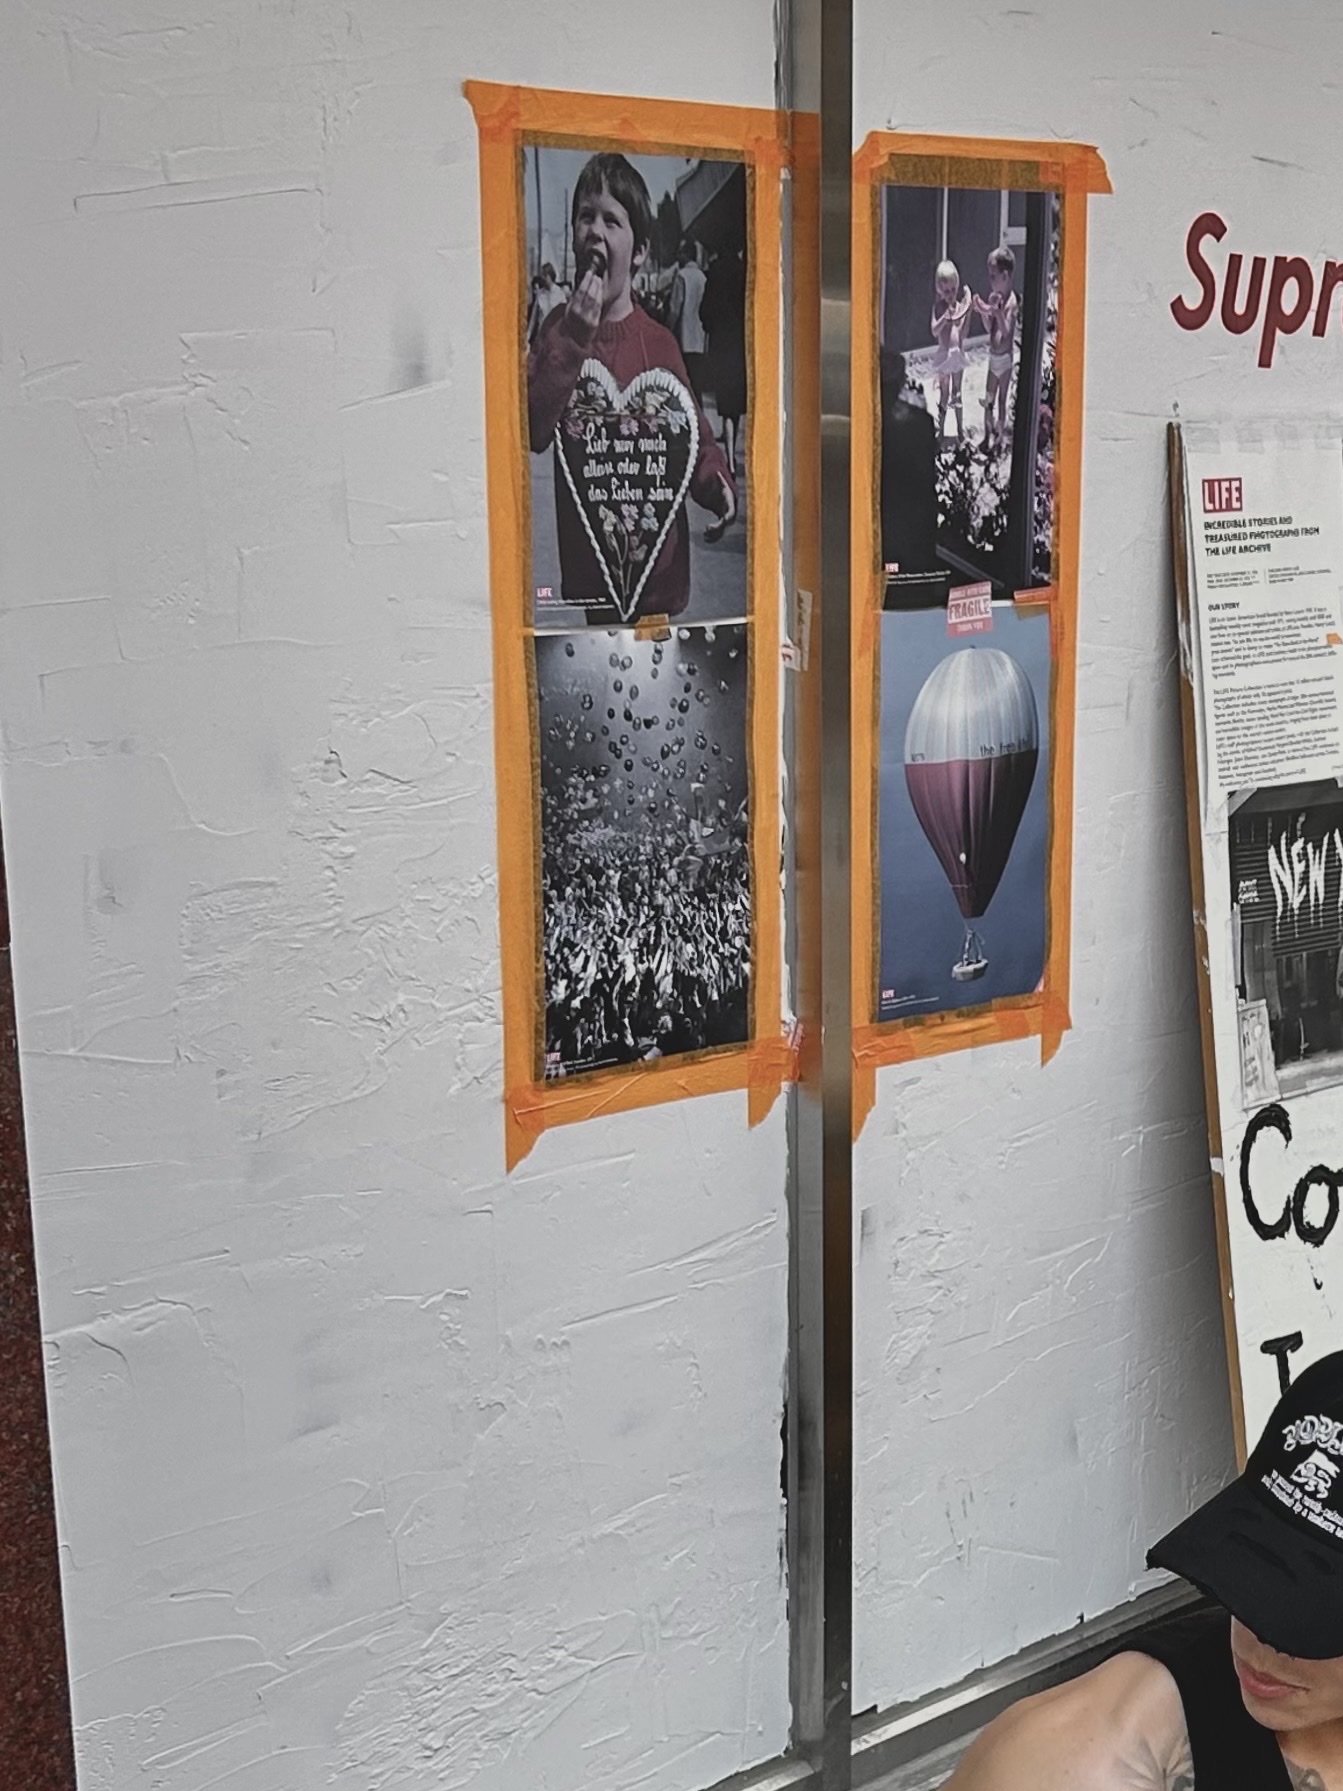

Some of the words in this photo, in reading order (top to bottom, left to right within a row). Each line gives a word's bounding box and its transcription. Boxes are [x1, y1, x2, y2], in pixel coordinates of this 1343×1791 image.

[1204, 479, 1242, 512] LIFE
[949, 598, 991, 620] FRAGILE
[1267, 831, 1331, 918] NEW
